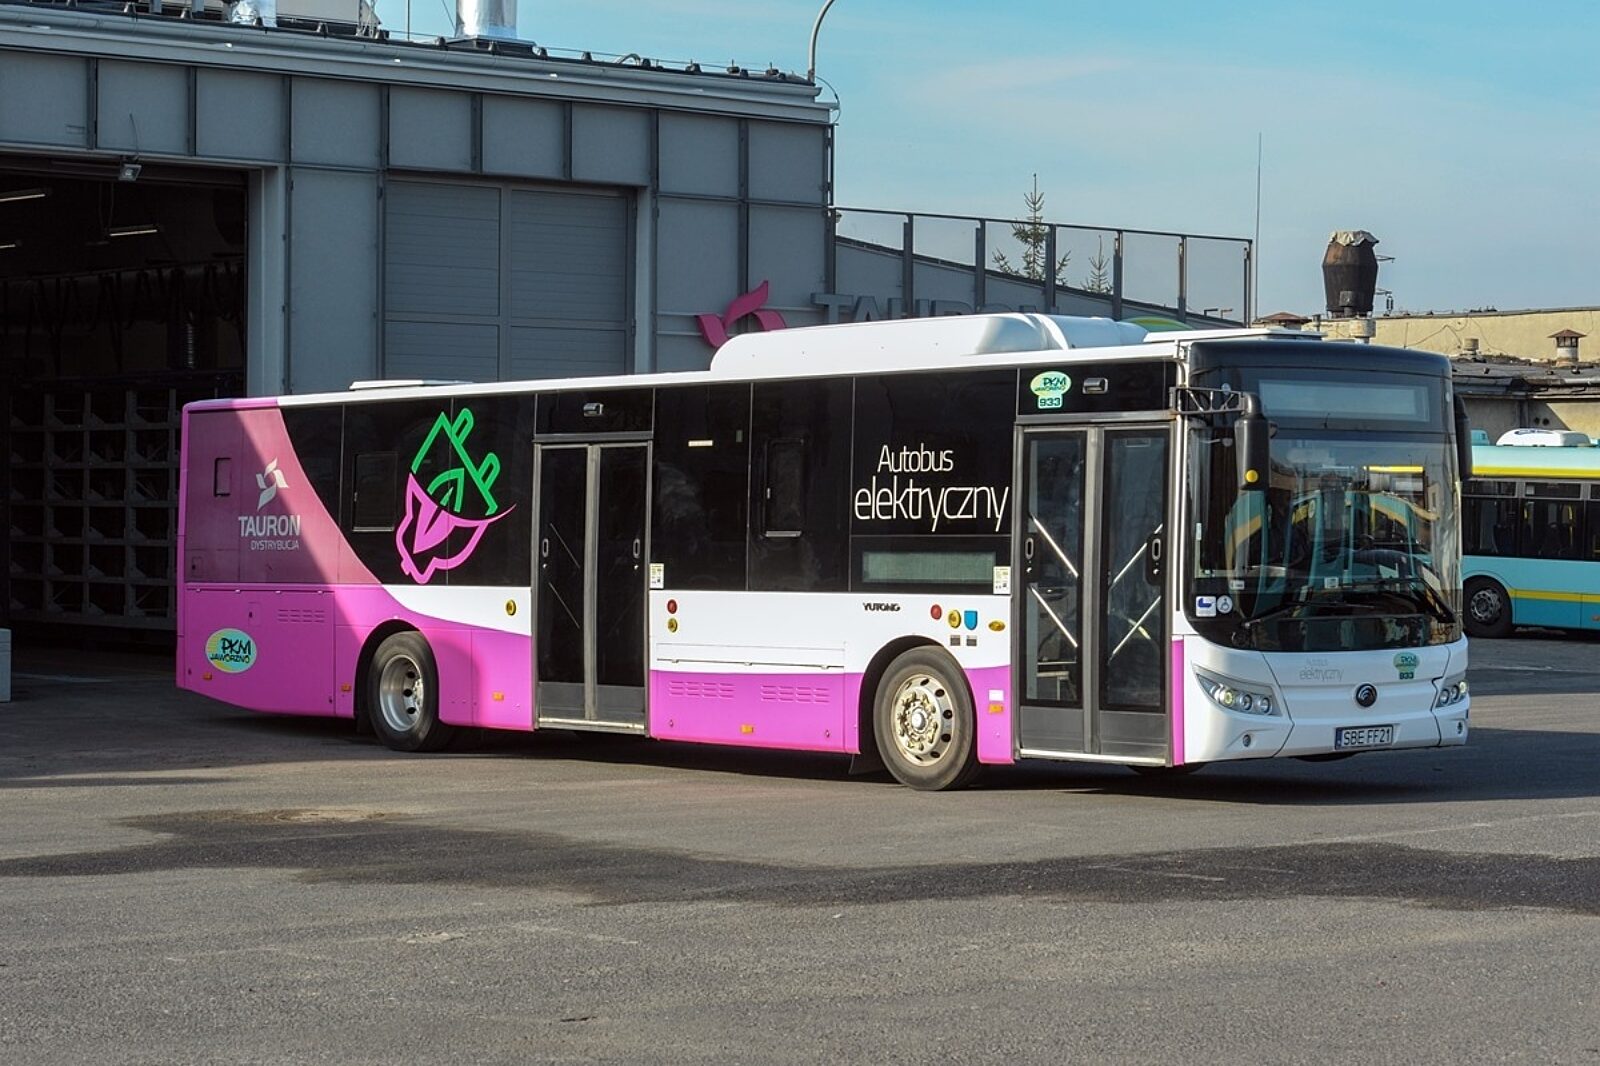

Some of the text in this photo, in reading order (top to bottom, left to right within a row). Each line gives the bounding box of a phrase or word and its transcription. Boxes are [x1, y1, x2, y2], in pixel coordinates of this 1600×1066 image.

[1043, 376, 1066, 387] PKM
[1039, 397, 1061, 407] 933
[877, 442, 954, 473] Autobus
[854, 475, 1010, 532] elektryczny
[238, 514, 301, 537] TAURON
[250, 539, 300, 551] DYSTRYBUCJA
[863, 602, 901, 612] YUTONG
[220, 637, 252, 656] PKM
[1343, 728, 1390, 746] SBE FF21
